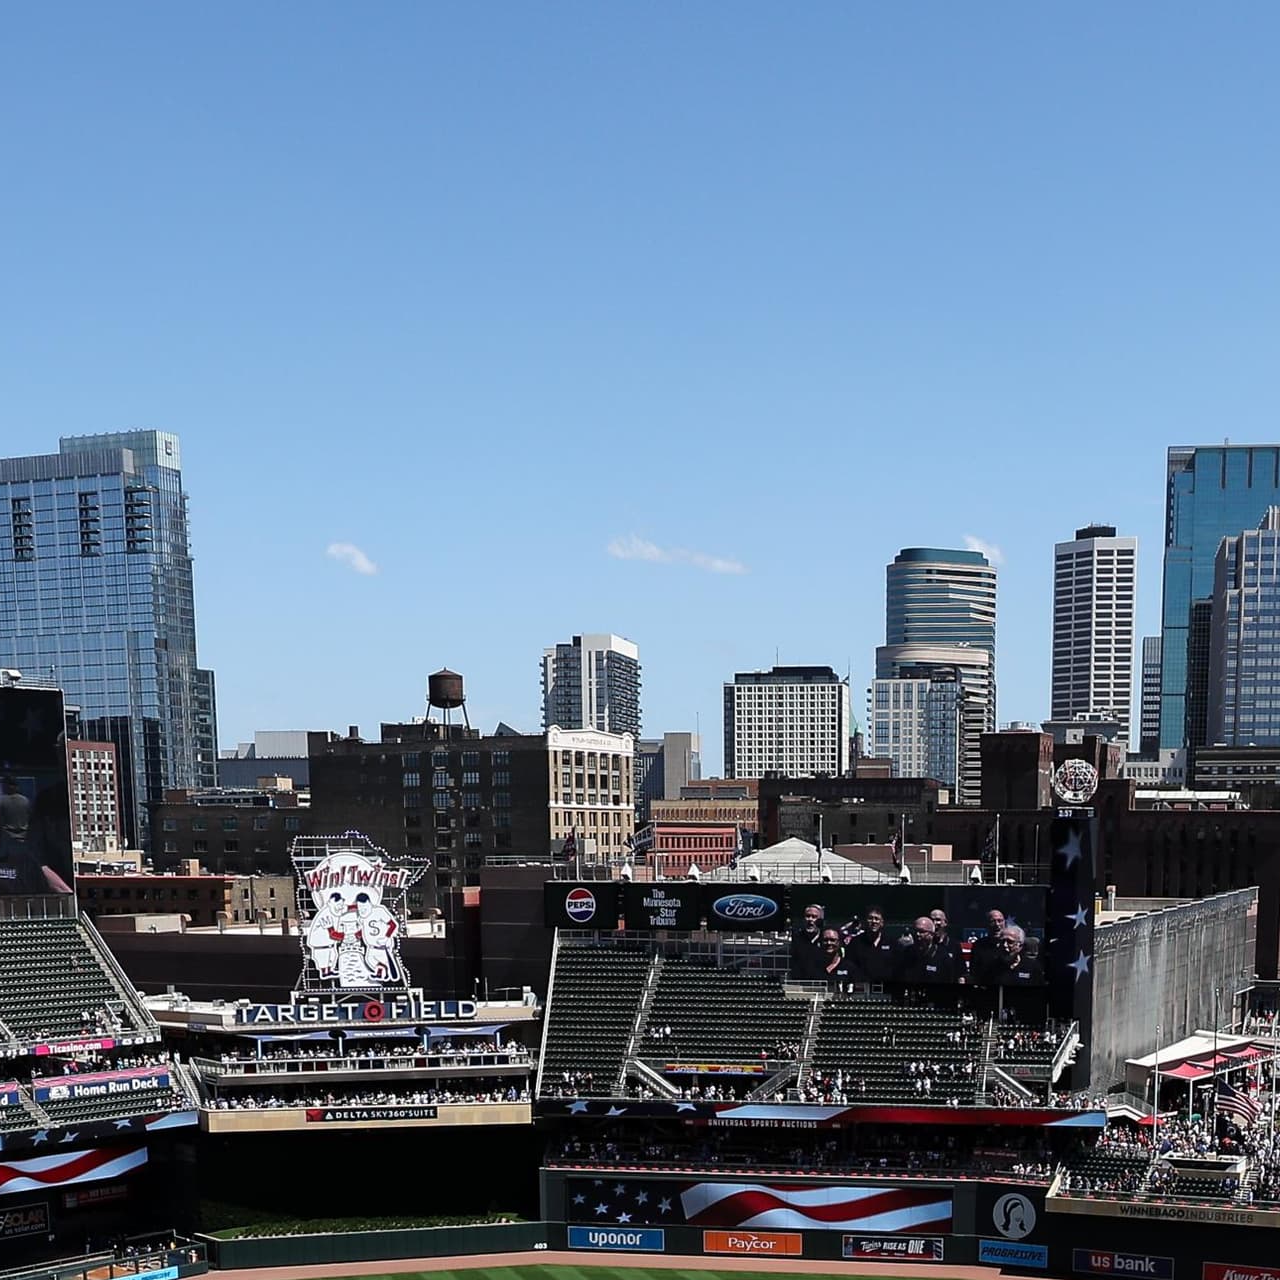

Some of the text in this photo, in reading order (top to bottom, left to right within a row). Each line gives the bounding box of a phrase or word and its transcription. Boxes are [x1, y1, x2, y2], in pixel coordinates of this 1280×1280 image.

[306, 862, 409, 892] Win! Twins!
[651, 888, 666, 898] The
[567, 901, 594, 910] PEPSI
[643, 898, 681, 908] Minnesota
[724, 897, 765, 918] Ford
[659, 907, 677, 917] Star
[368, 919, 380, 937] S
[649, 916, 677, 926] Tribune
[236, 999, 478, 1024] TARGET FIELD
[73, 1075, 160, 1098] Home Run Deck
[335, 1111, 369, 1119] DELTA
[408, 1108, 435, 1118] SUITE
[708, 1118, 818, 1129] UNIVERSAL SPORTS AUCTIONS
[533, 1242, 548, 1250] 403
[588, 1230, 642, 1247] uponor
[728, 1236, 776, 1252] Paycor
[859, 1239, 925, 1255] Twins RISE AS ONE
[981, 1246, 1044, 1262] PROGRESSIVE
[1090, 1253, 1156, 1273] us bank
